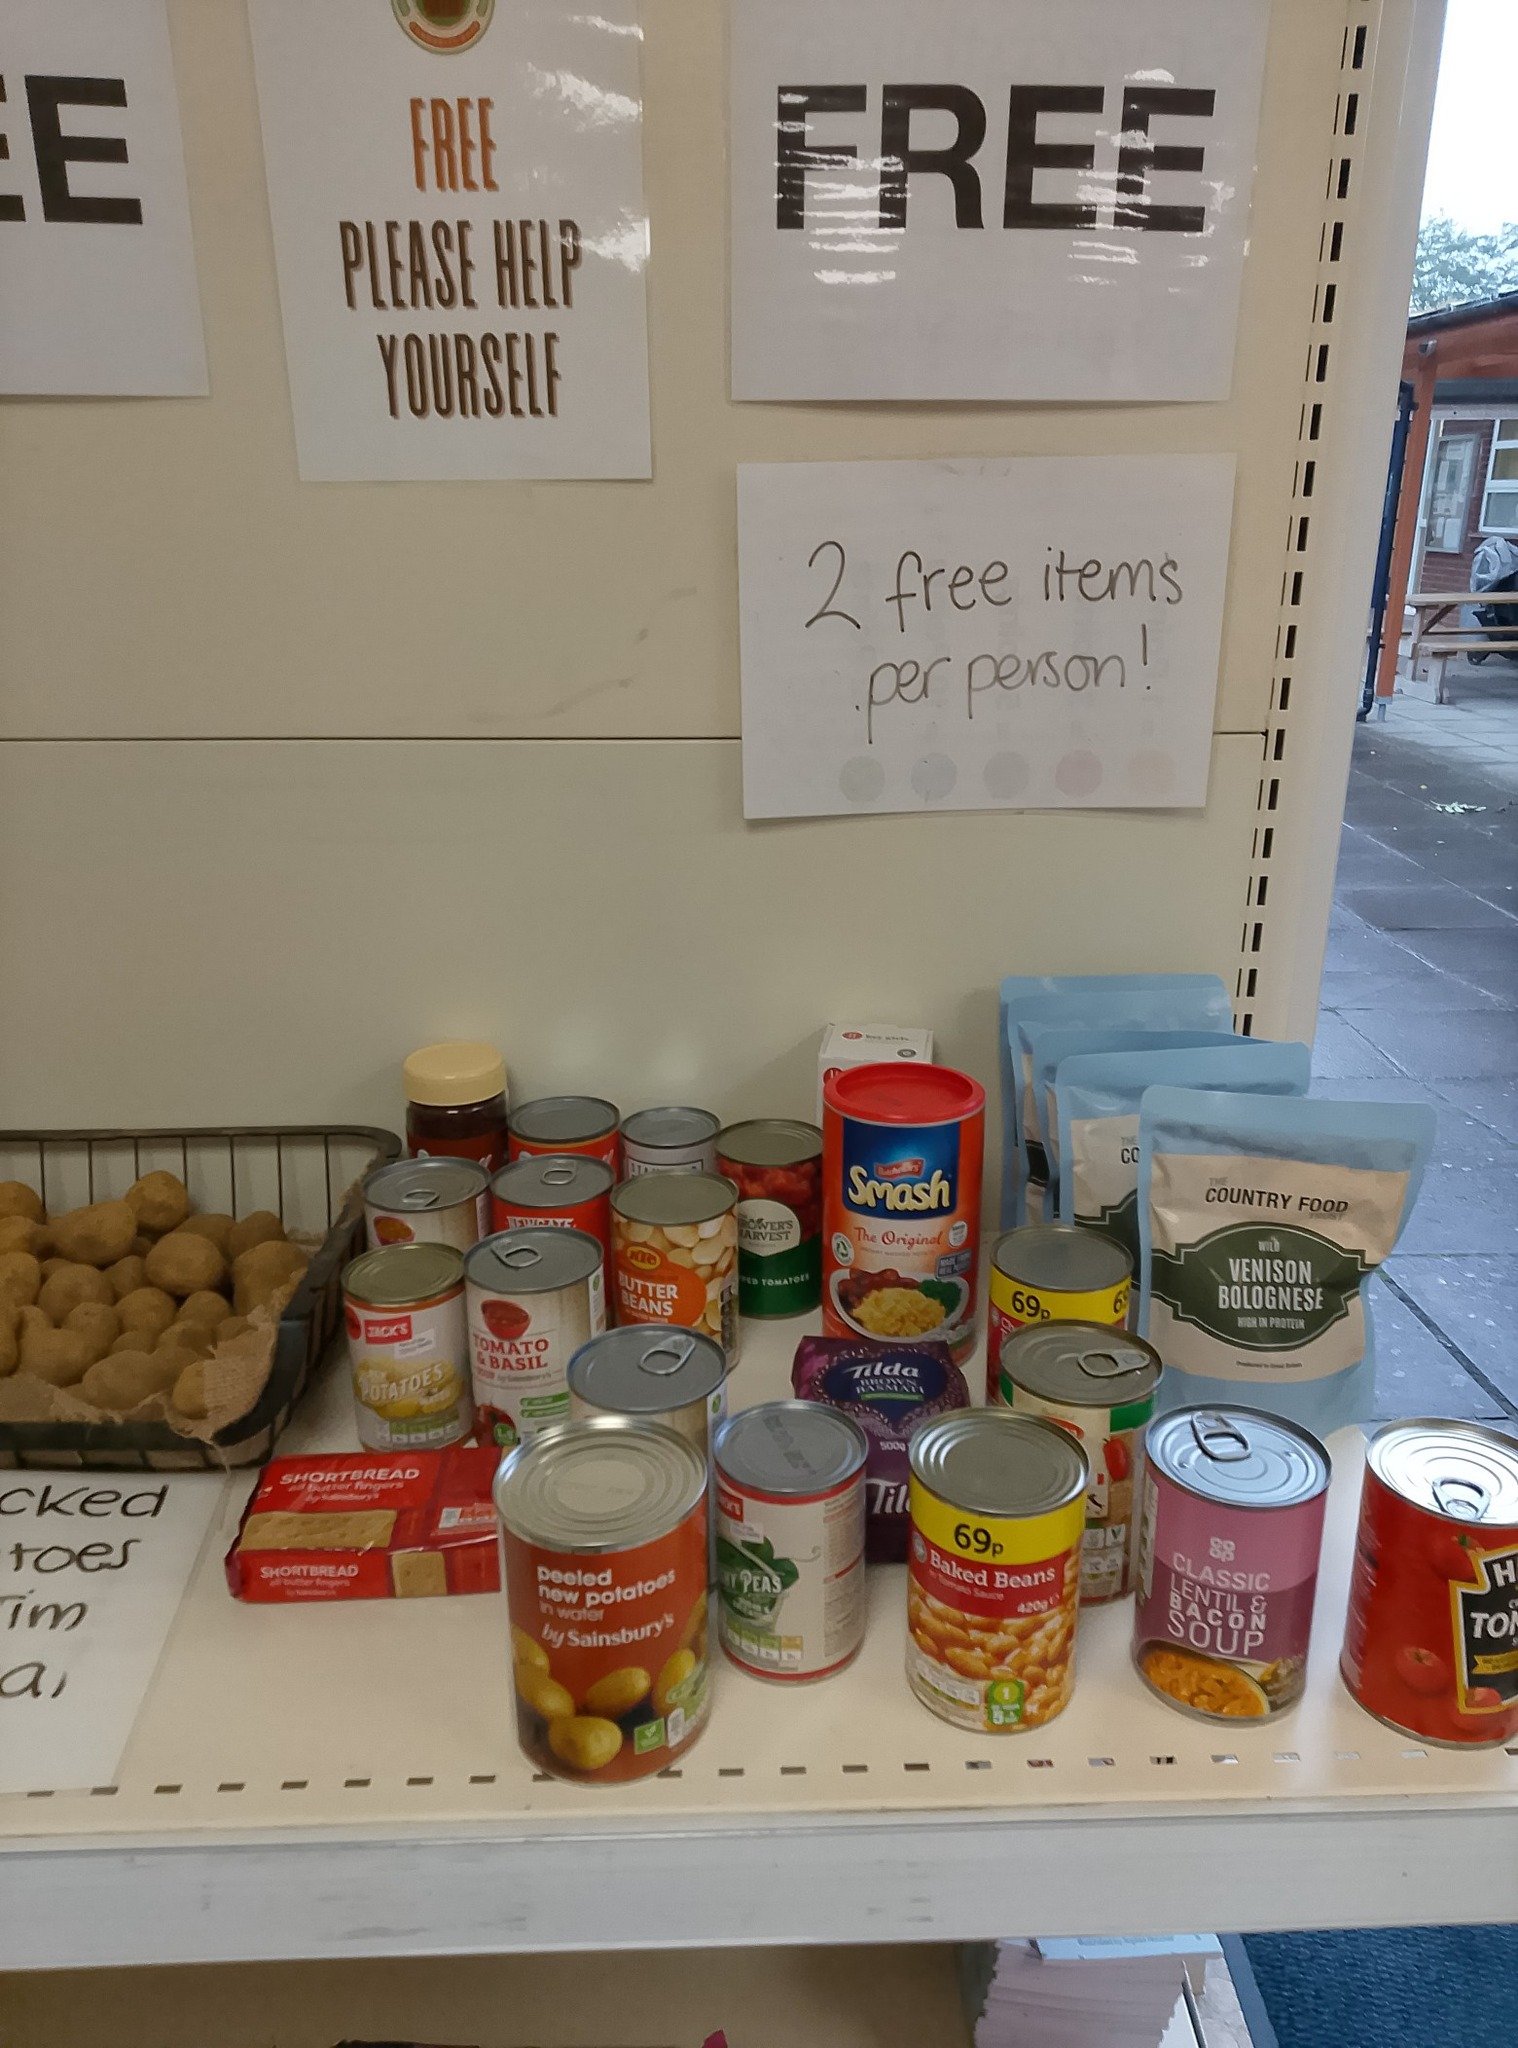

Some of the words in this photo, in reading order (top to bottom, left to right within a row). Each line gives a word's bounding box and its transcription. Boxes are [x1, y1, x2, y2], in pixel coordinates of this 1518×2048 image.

[0, 75, 143, 224] E
[409, 97, 499, 192] FREE
[775, 84, 1215, 231] FREE
[339, 220, 477, 310] PLEASE
[494, 219, 582, 309] HELP
[377, 332, 562, 419] YOURSELF
[805, 540, 860, 629] 2
[885, 550, 1012, 632] free
[1042, 547, 1182, 604] items
[863, 653, 951, 744] per
[966, 624, 1152, 719] person!
[848, 1165, 950, 1211] Smash
[1205, 1187, 1292, 1210] COUNTRY
[1299, 1196, 1349, 1213] FOOD
[854, 1227, 877, 1244] The
[881, 1230, 942, 1250] Original
[618, 1270, 678, 1299] BUTTER
[1229, 1258, 1312, 1285] VENISON
[621, 1289, 673, 1316] BEANS
[1012, 1290, 1050, 1320] 69p
[1218, 1285, 1324, 1311] BOLOGNESE
[474, 1333, 549, 1356] TOMATO
[489, 1355, 548, 1371] BASIL
[843, 1362, 919, 1379] Tilda
[361, 1363, 443, 1401] POTATOES
[880, 1441, 906, 1452] 500g
[280, 1469, 420, 1485] SHORTBREAD
[863, 1479, 909, 1515] Til
[10, 1539, 141, 1573] toes
[954, 1523, 1004, 1557] 69p
[260, 1565, 359, 1579] SHORTBREAD
[537, 1566, 613, 1587] peeled
[740, 1570, 782, 1594] PEAS
[930, 1549, 988, 1587] Baked
[994, 1566, 1056, 1589] Beans
[1173, 1552, 1271, 1592] CLASSIC
[538, 1584, 579, 1604] new
[585, 1569, 676, 1608] potatoes
[1170, 1573, 1245, 1614] LENTIL
[1250, 1595, 1267, 1614] &
[1169, 1591, 1266, 1631] BACON
[541, 1623, 564, 1649] by
[567, 1613, 675, 1648] Sainsbury's
[1167, 1609, 1264, 1656] SOUP
